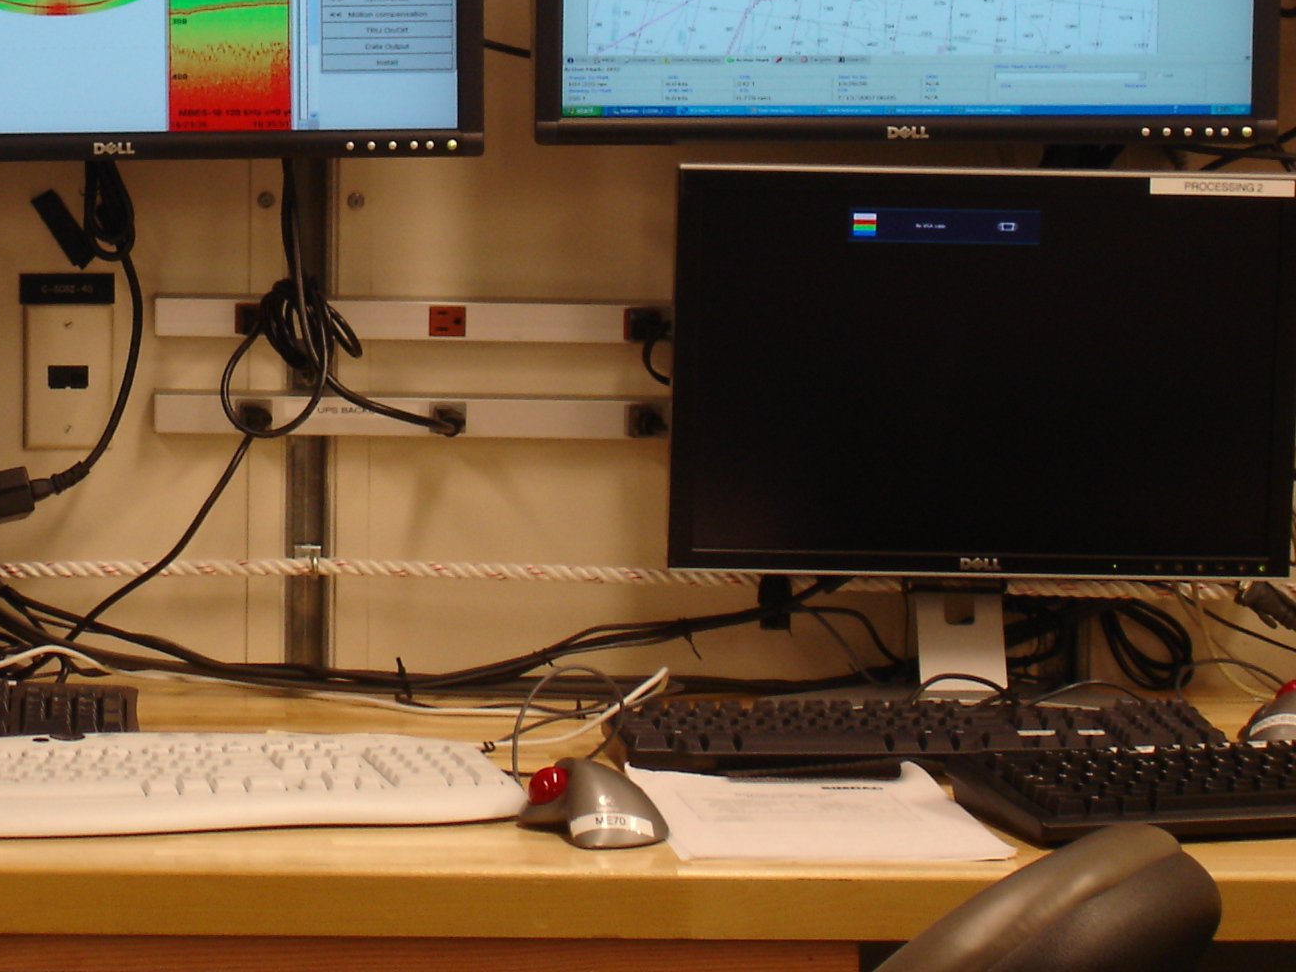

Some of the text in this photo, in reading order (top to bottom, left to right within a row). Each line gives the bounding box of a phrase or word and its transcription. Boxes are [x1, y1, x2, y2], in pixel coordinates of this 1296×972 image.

[887, 125, 929, 139] DELL
[93, 141, 135, 154] DELL
[1184, 181, 1255, 193] PROCESSING
[960, 557, 1002, 570] DELL
